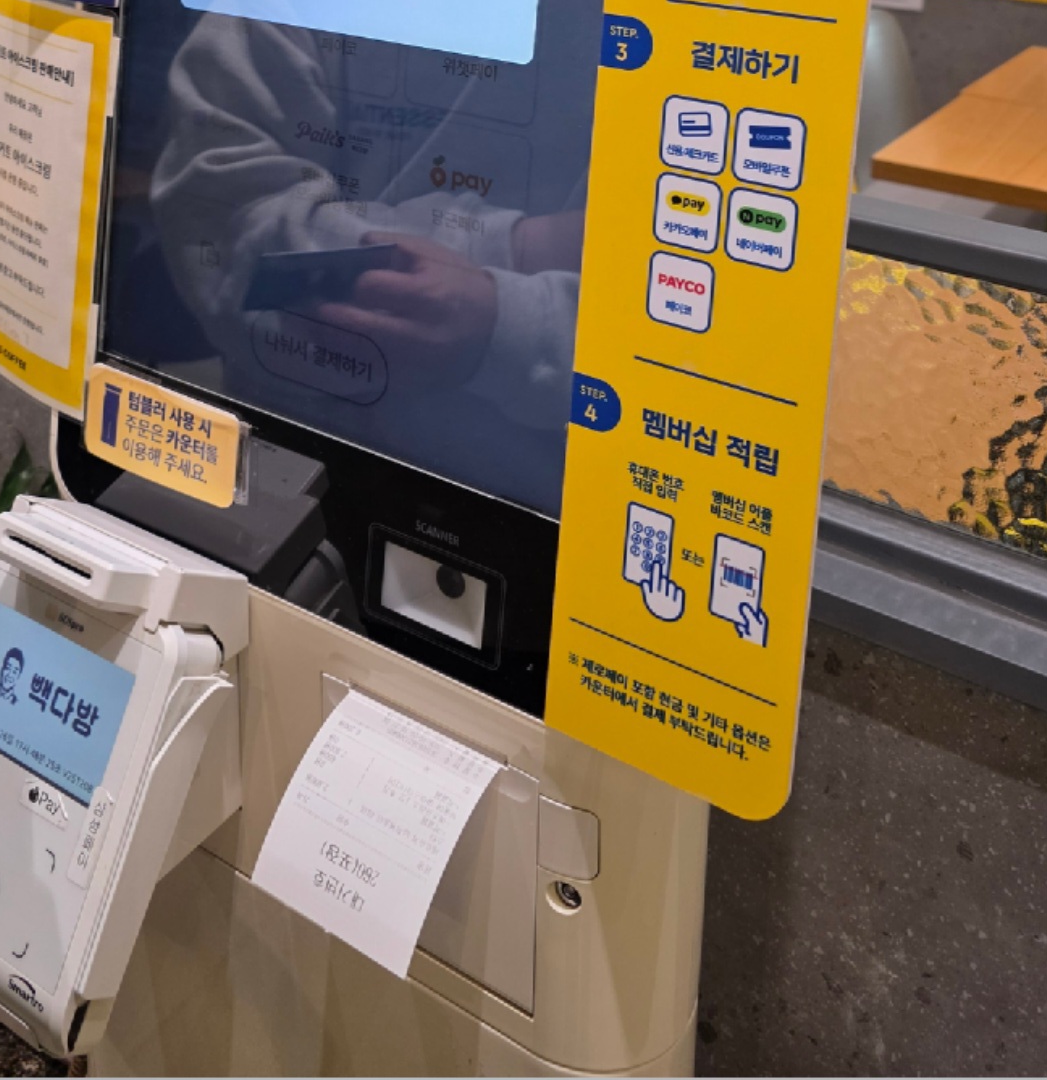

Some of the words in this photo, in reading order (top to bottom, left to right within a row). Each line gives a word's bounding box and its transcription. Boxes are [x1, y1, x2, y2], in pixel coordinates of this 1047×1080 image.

[610, 26, 638, 38] STEP.
[616, 43, 628, 60] 3
[691, 41, 799, 84] 결제하기
[442, 58, 498, 81] 위챗페이
[12, 150, 52, 179] 아이스크림
[451, 171, 493, 197] pay
[682, 197, 705, 212] pay
[663, 220, 708, 241] 카카오페이
[736, 237, 783, 259] 네이버페이
[658, 273, 706, 296] PAYCO
[264, 330, 308, 362] 나눠서
[313, 345, 373, 382] 결제하기
[580, 385, 607, 402] STEP.
[129, 391, 167, 421] 텀블러
[169, 408, 195, 429] 사용
[199, 420, 211, 438] 시
[584, 404, 598, 422] 4
[125, 415, 164, 442] 주문은
[166, 428, 219, 465] 카운터를
[642, 408, 718, 456] 멤버십
[726, 434, 779, 476] 적립
[123, 438, 161, 467] 이용해
[164, 453, 207, 484] 주세요.
[628, 461, 659, 482] 휴대폰
[662, 473, 684, 491] 번호
[632, 476, 653, 495] 직접
[655, 485, 678, 502] 입력
[710, 504, 745, 525] 바코드
[416, 520, 460, 546] SCANNER
[681, 548, 705, 567] 또는
[28, 672, 99, 738] 빽다방
[580, 674, 638, 712] 카운터에서
[642, 702, 666, 724] 결제
[669, 715, 749, 761] 부탁드립니다.
[582, 658, 628, 689] 제로페이
[631, 679, 656, 701] 포함
[659, 691, 684, 712] 현금
[702, 711, 728, 733] 기타
[732, 723, 772, 751] 옵션은
